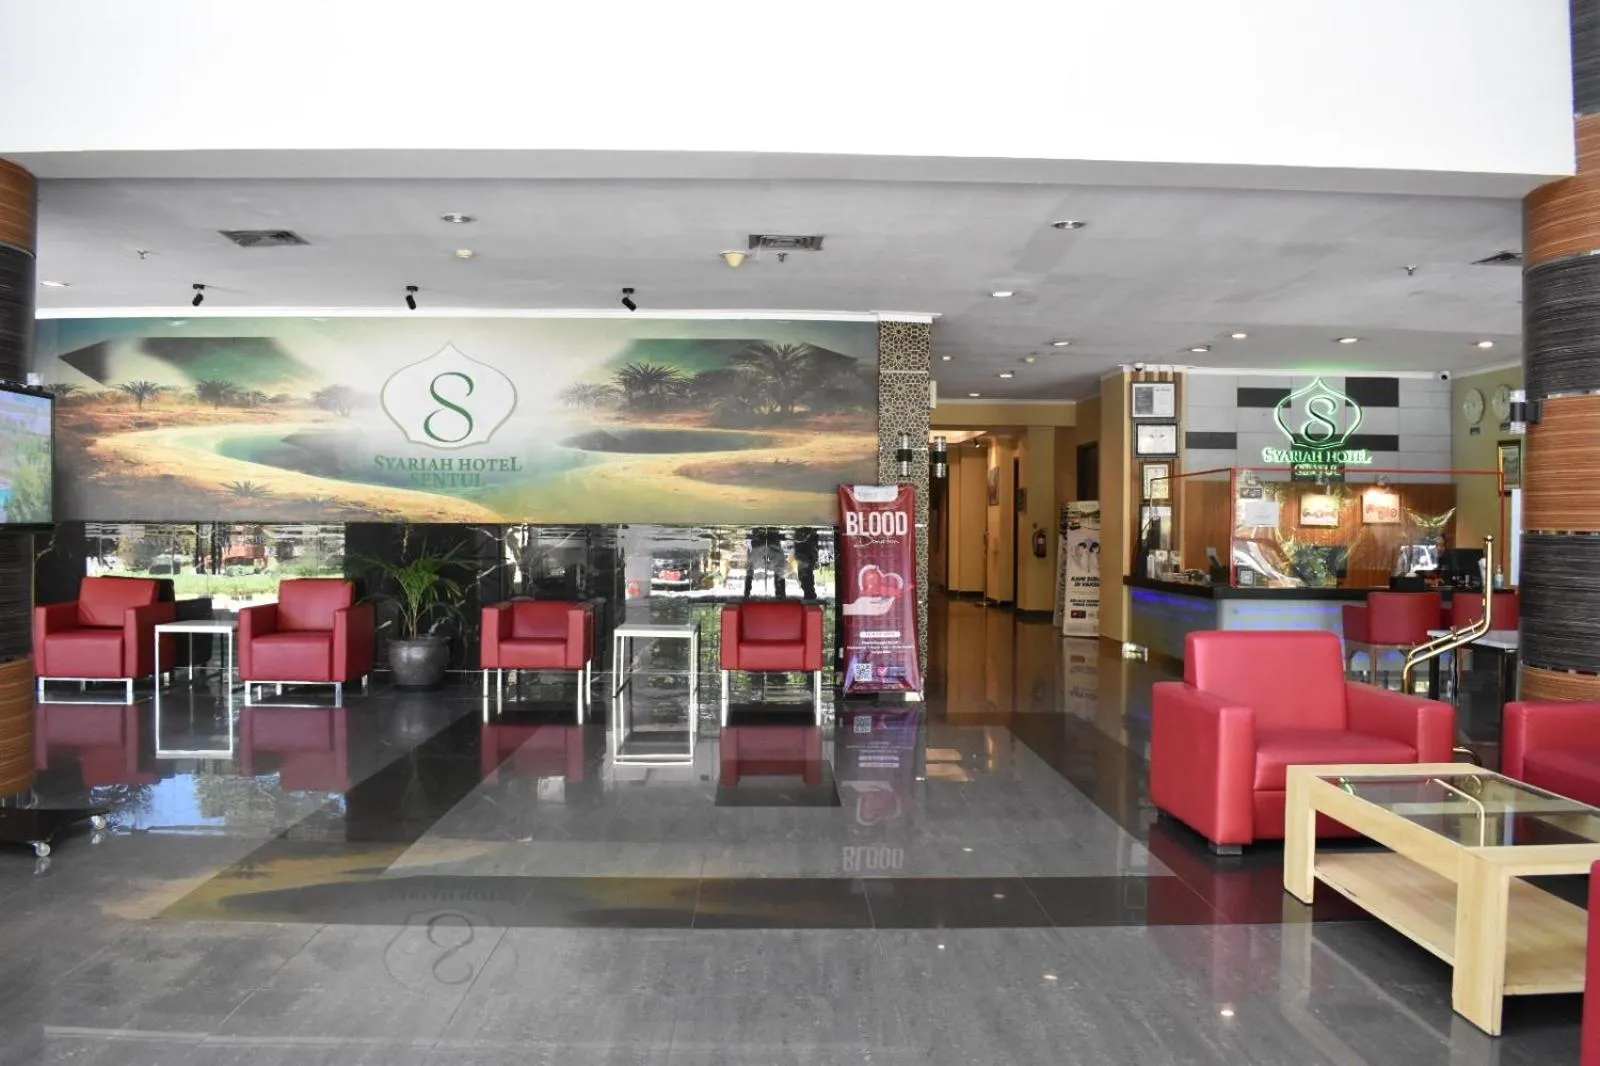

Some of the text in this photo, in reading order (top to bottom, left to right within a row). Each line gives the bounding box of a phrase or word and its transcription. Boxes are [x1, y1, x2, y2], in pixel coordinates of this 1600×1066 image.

[374, 455, 523, 472] SYARIAH HOTEL
[1261, 446, 1373, 464] SYARIAH HOTEL
[410, 472, 486, 488] SENTUL
[846, 511, 908, 537] BLOOD
